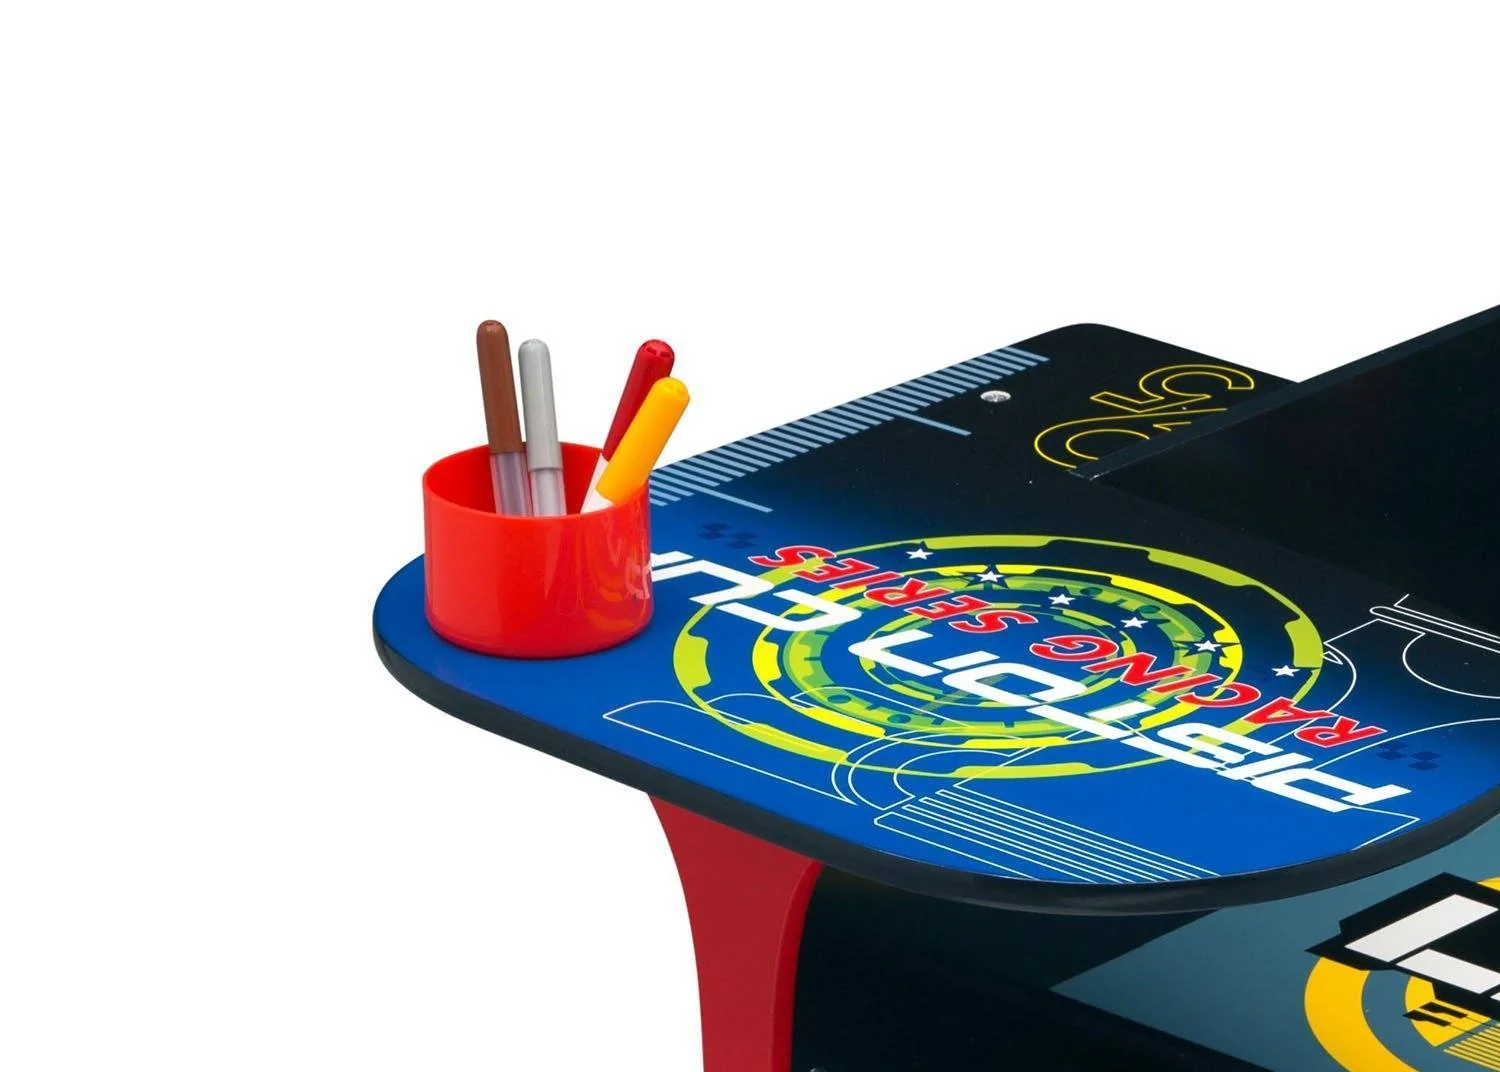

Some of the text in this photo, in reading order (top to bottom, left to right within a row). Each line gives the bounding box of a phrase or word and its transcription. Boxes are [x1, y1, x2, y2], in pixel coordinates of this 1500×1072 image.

[651, 550, 863, 632] CU
[747, 545, 1388, 749] RACING SERIES
